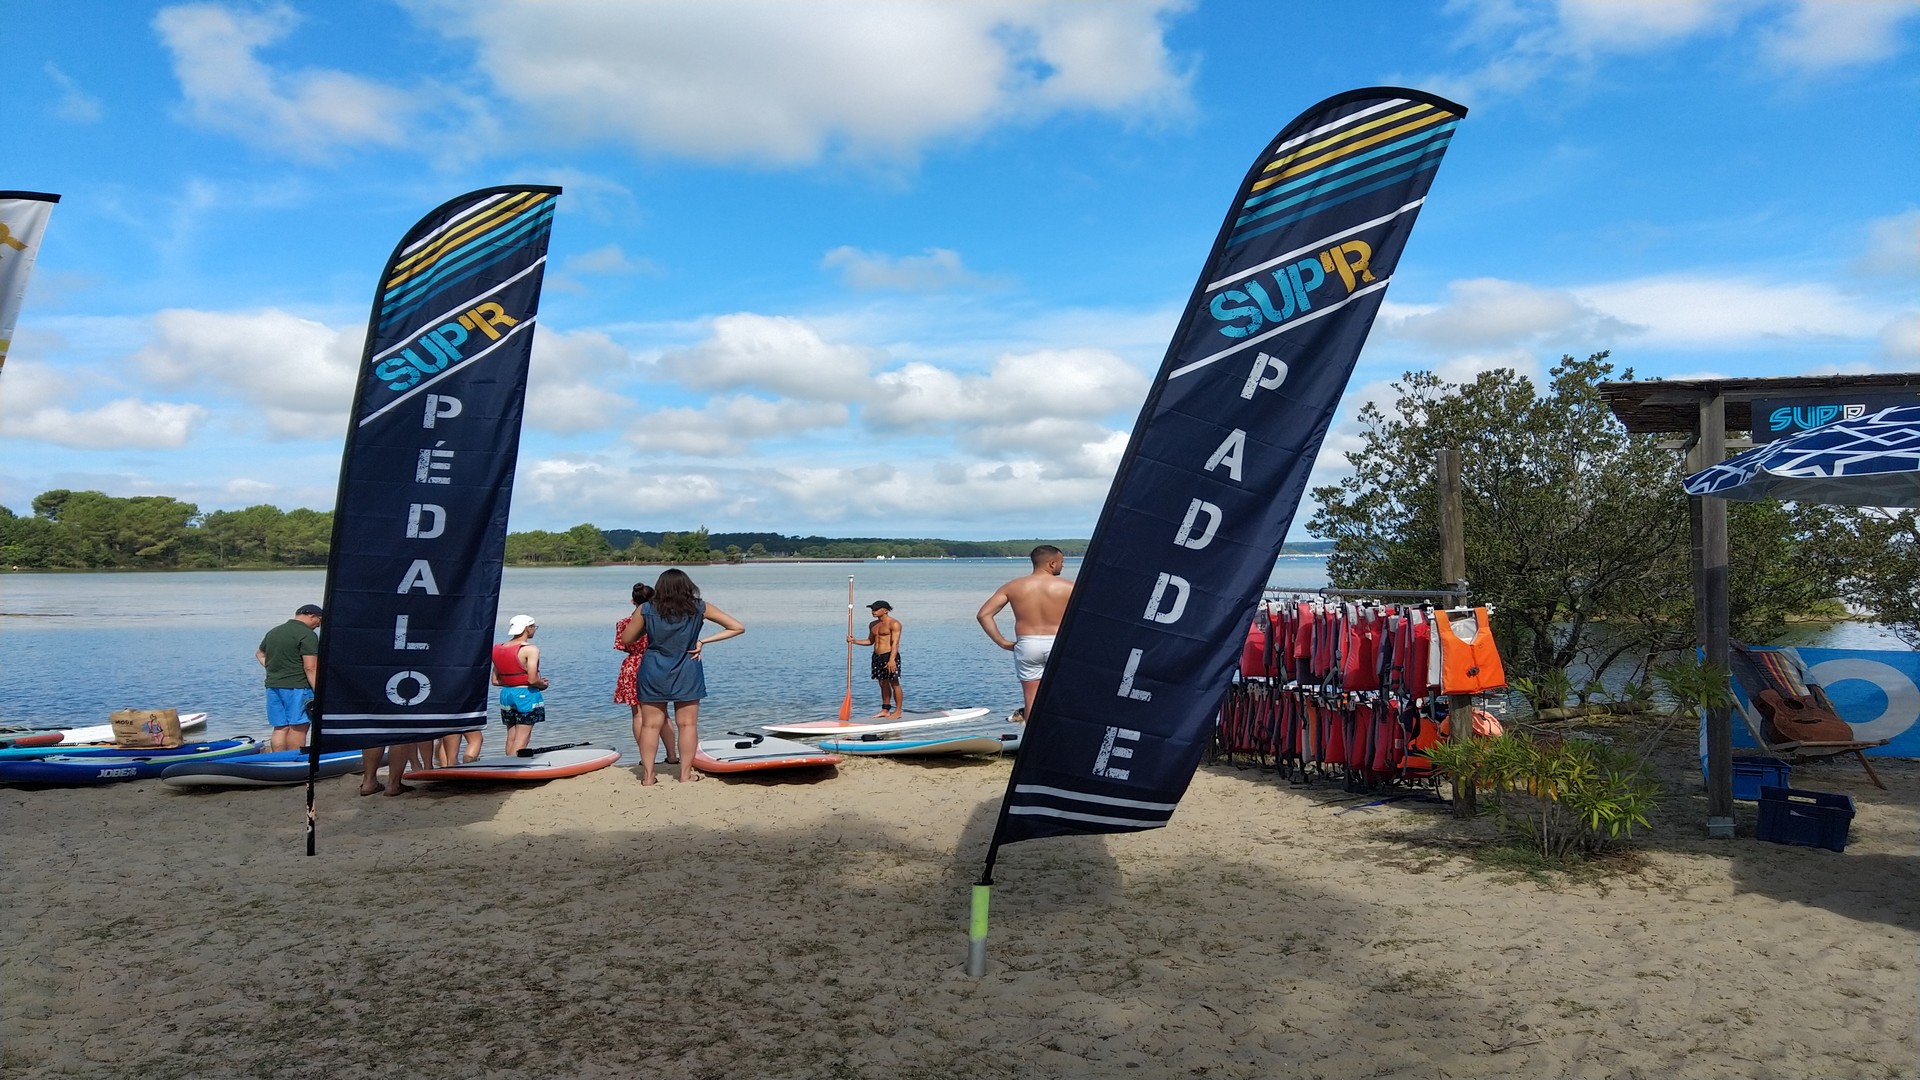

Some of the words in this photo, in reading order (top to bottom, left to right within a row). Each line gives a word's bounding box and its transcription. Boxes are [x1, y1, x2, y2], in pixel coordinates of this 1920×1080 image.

[1210, 239, 1376, 338] SUP'R
[375, 301, 519, 391] SUP'R
[385, 393, 463, 707] PÉDALO
[1092, 351, 1289, 781] PADDLE
[97, 768, 129, 778] JOBE
